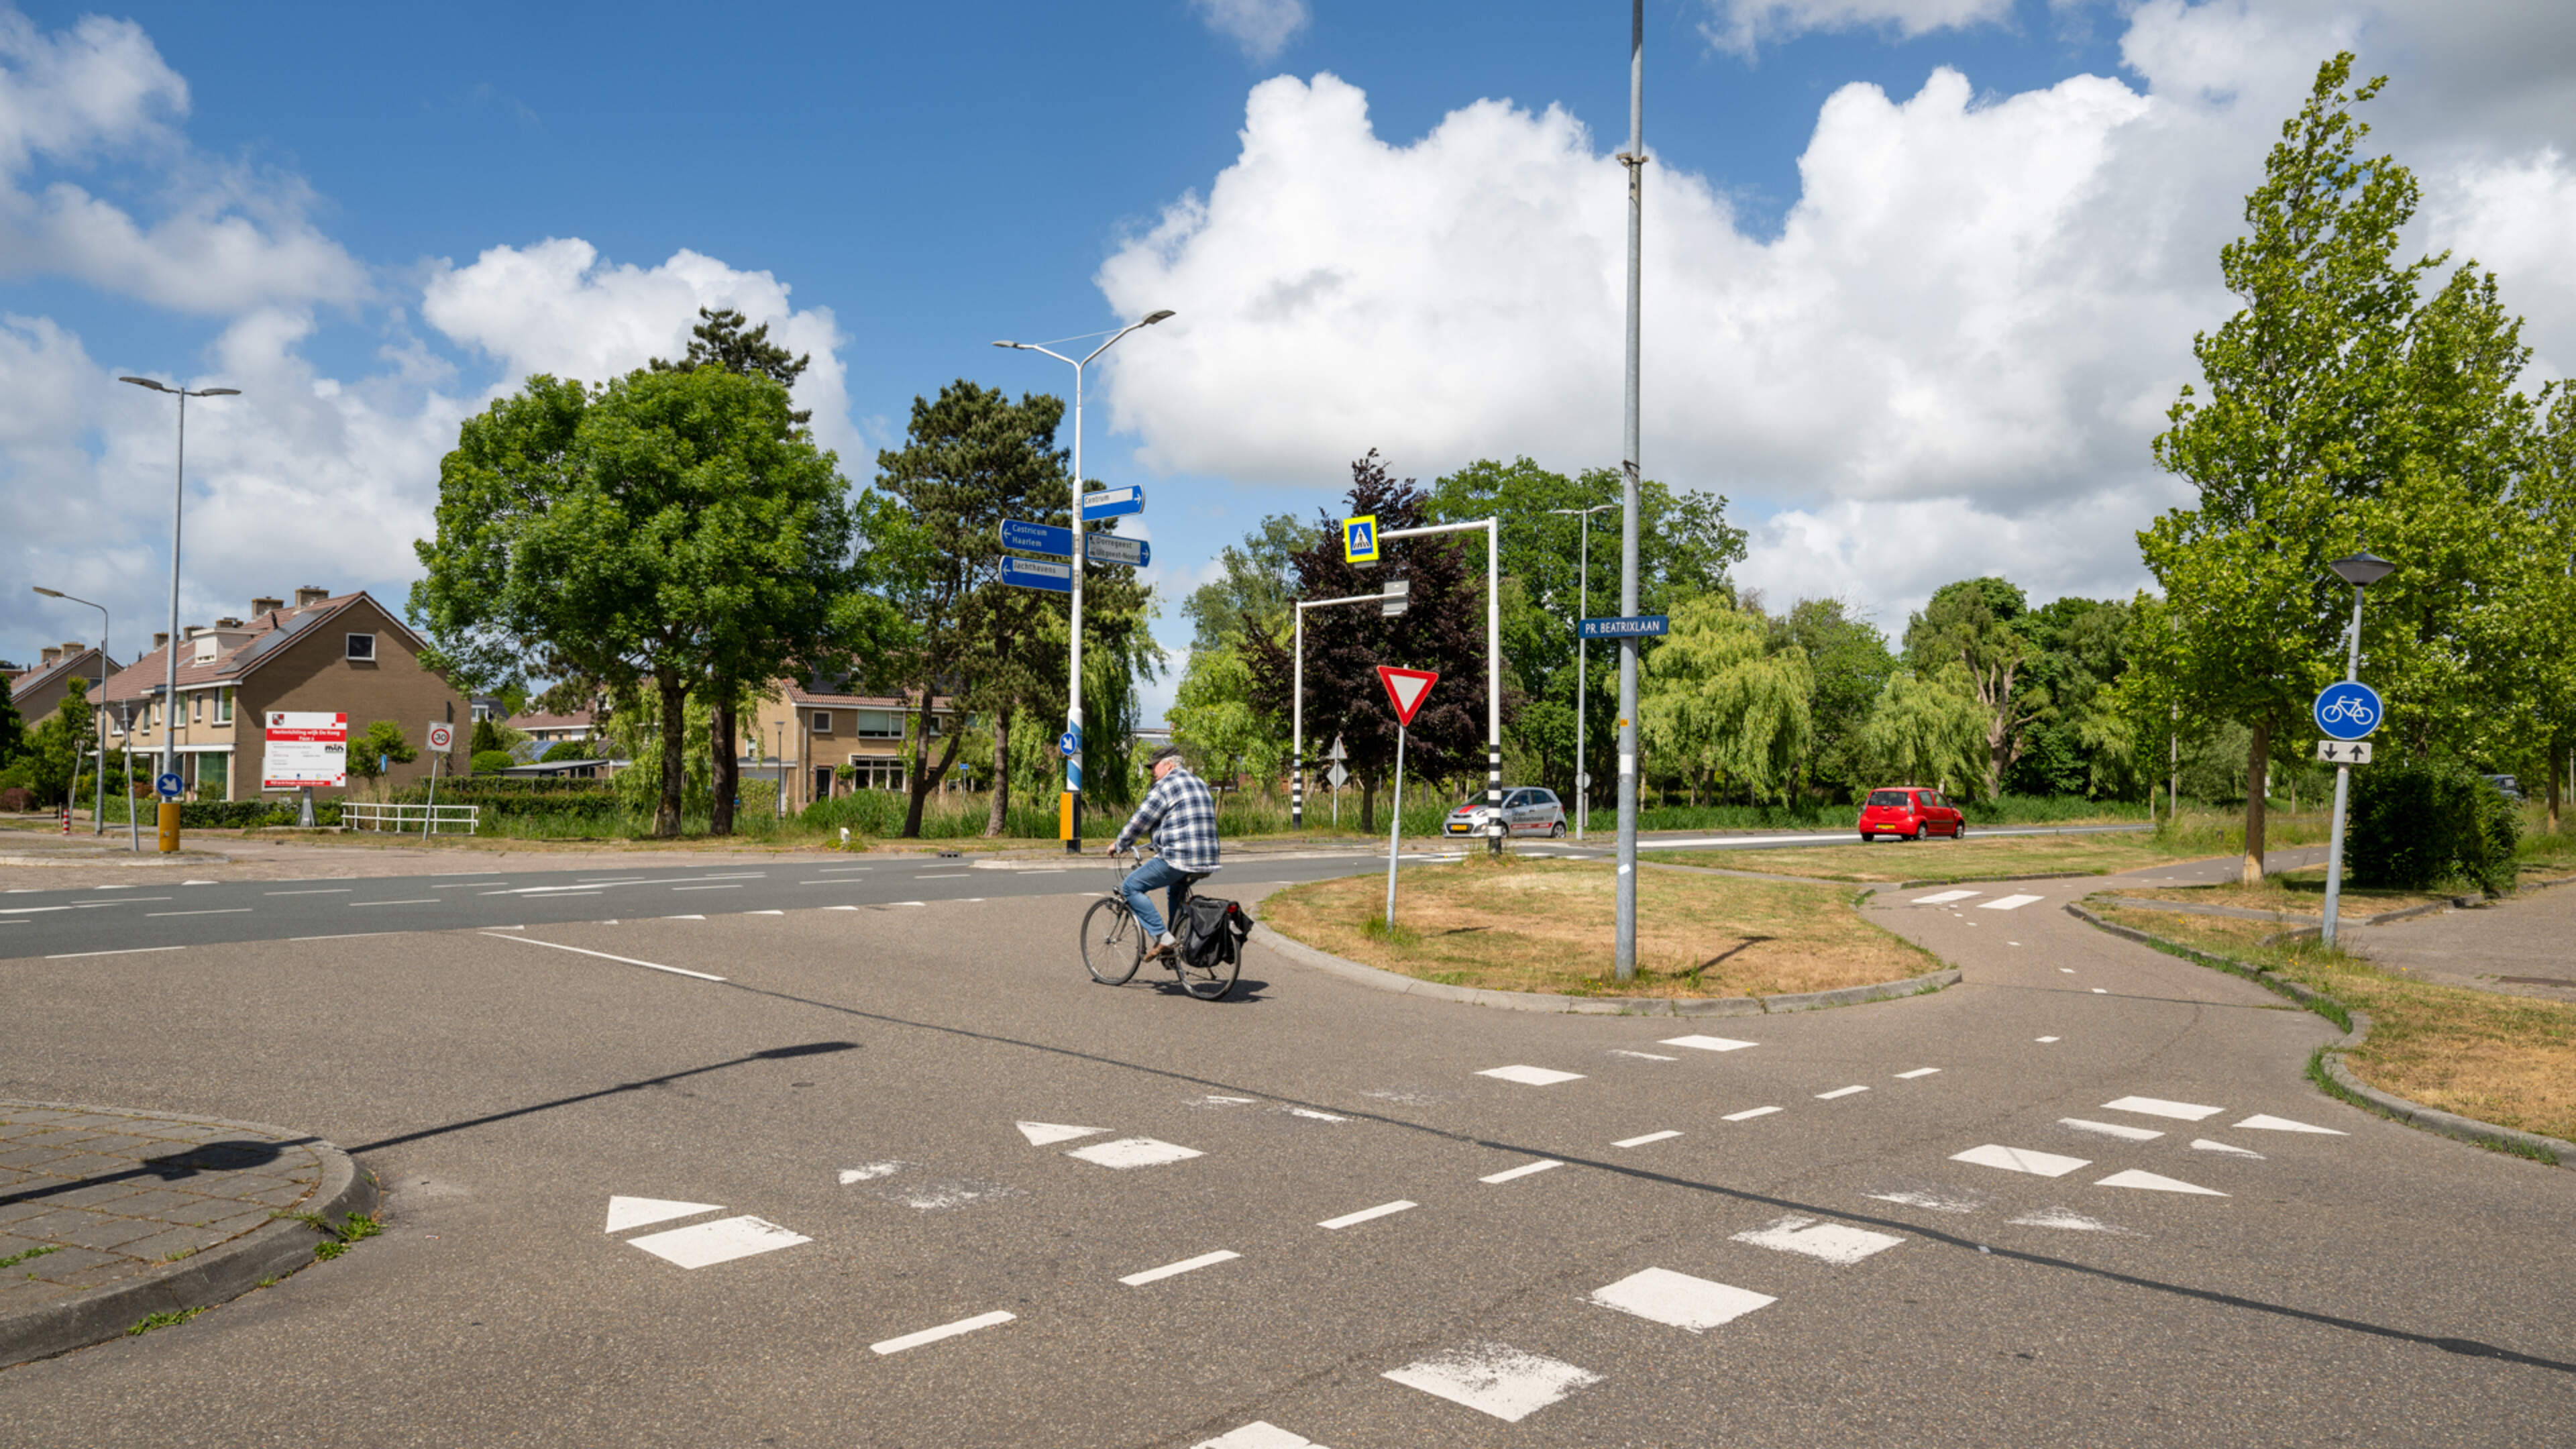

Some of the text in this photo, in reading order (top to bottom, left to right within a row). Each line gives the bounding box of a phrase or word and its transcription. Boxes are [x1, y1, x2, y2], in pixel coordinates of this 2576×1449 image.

[1085, 494, 1110, 505] Centrum
[1012, 525, 1047, 536] Castricum
[1012, 536, 1042, 547] Haarlem
[1097, 548, 1140, 560] Uitgeest-Noord
[1014, 561, 1057, 574] Jachthavens
[1585, 621, 1660, 634] PR. BEATRIXLAAN
